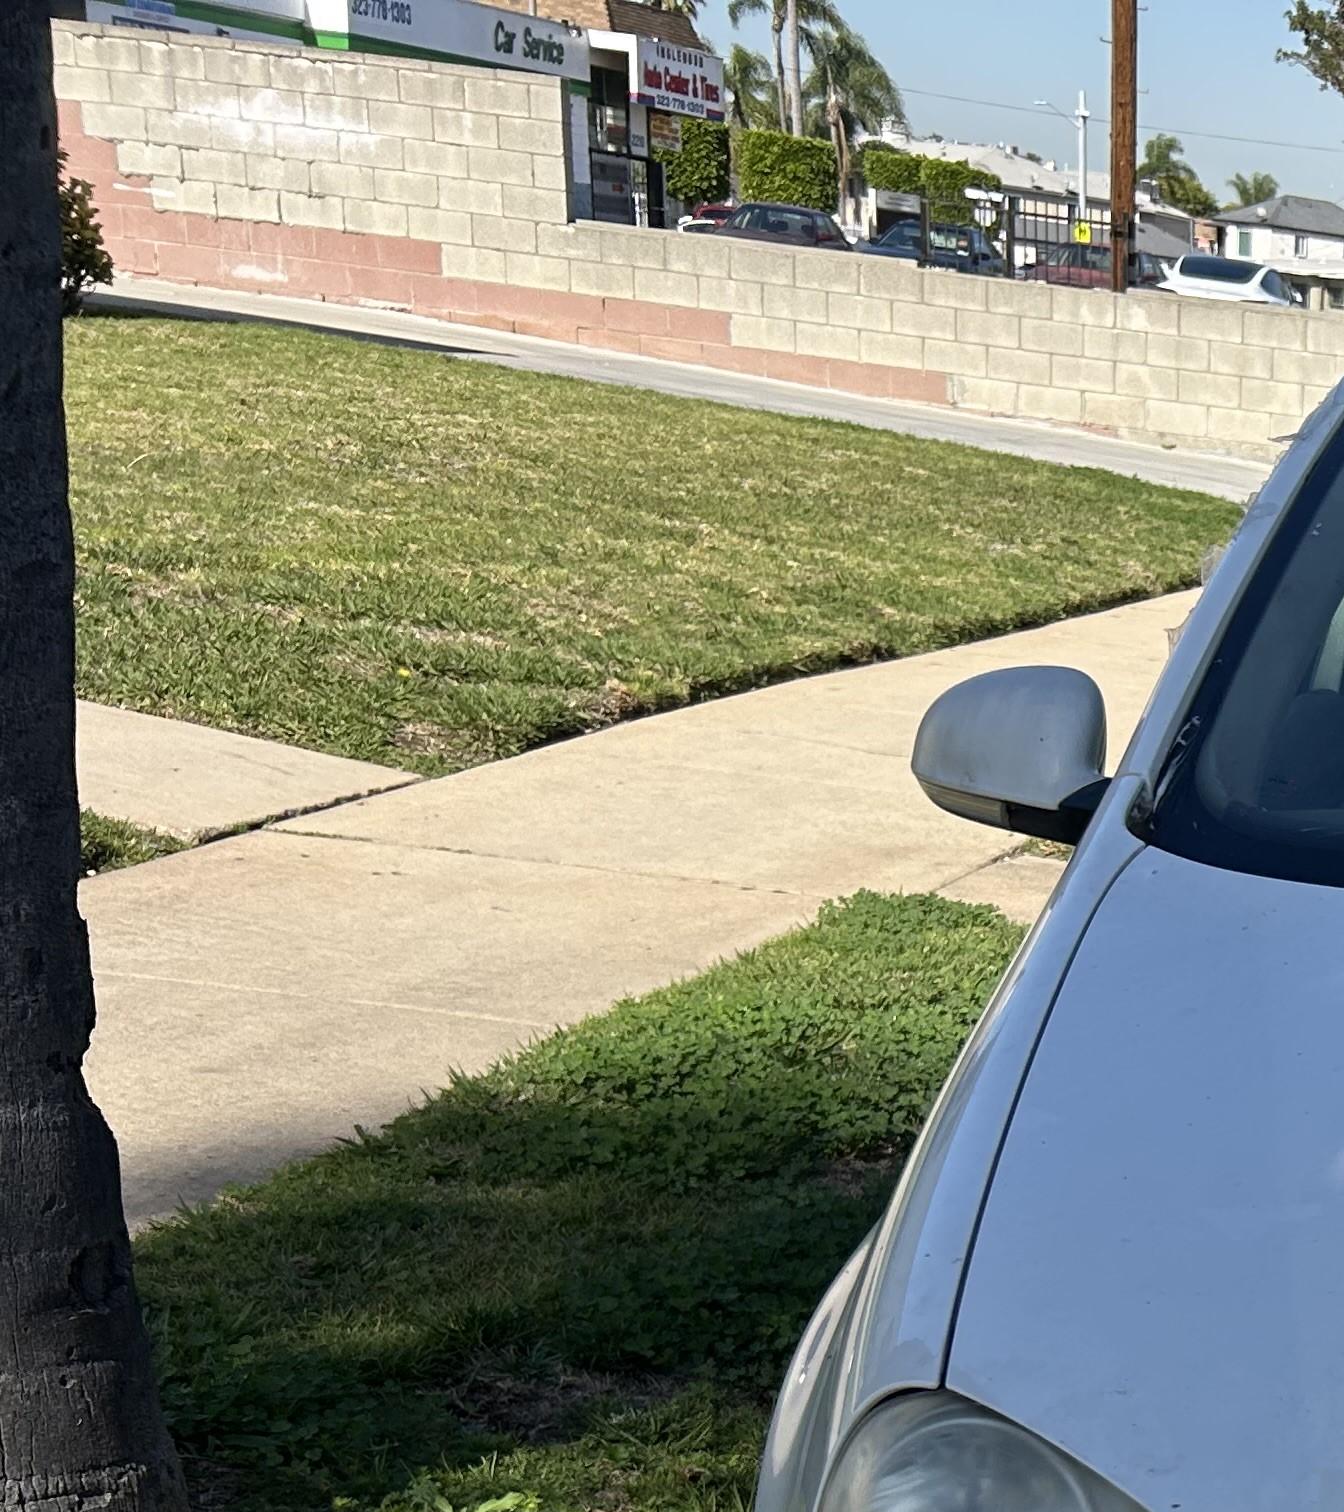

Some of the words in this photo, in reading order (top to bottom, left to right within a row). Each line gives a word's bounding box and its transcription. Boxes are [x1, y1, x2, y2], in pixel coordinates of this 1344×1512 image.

[494, 20, 516, 54] Car
[523, 27, 565, 65] Service
[643, 60, 662, 90] Auto
[664, 66, 690, 96] Center
[692, 73, 698, 98] &
[700, 75, 720, 103] Tires
